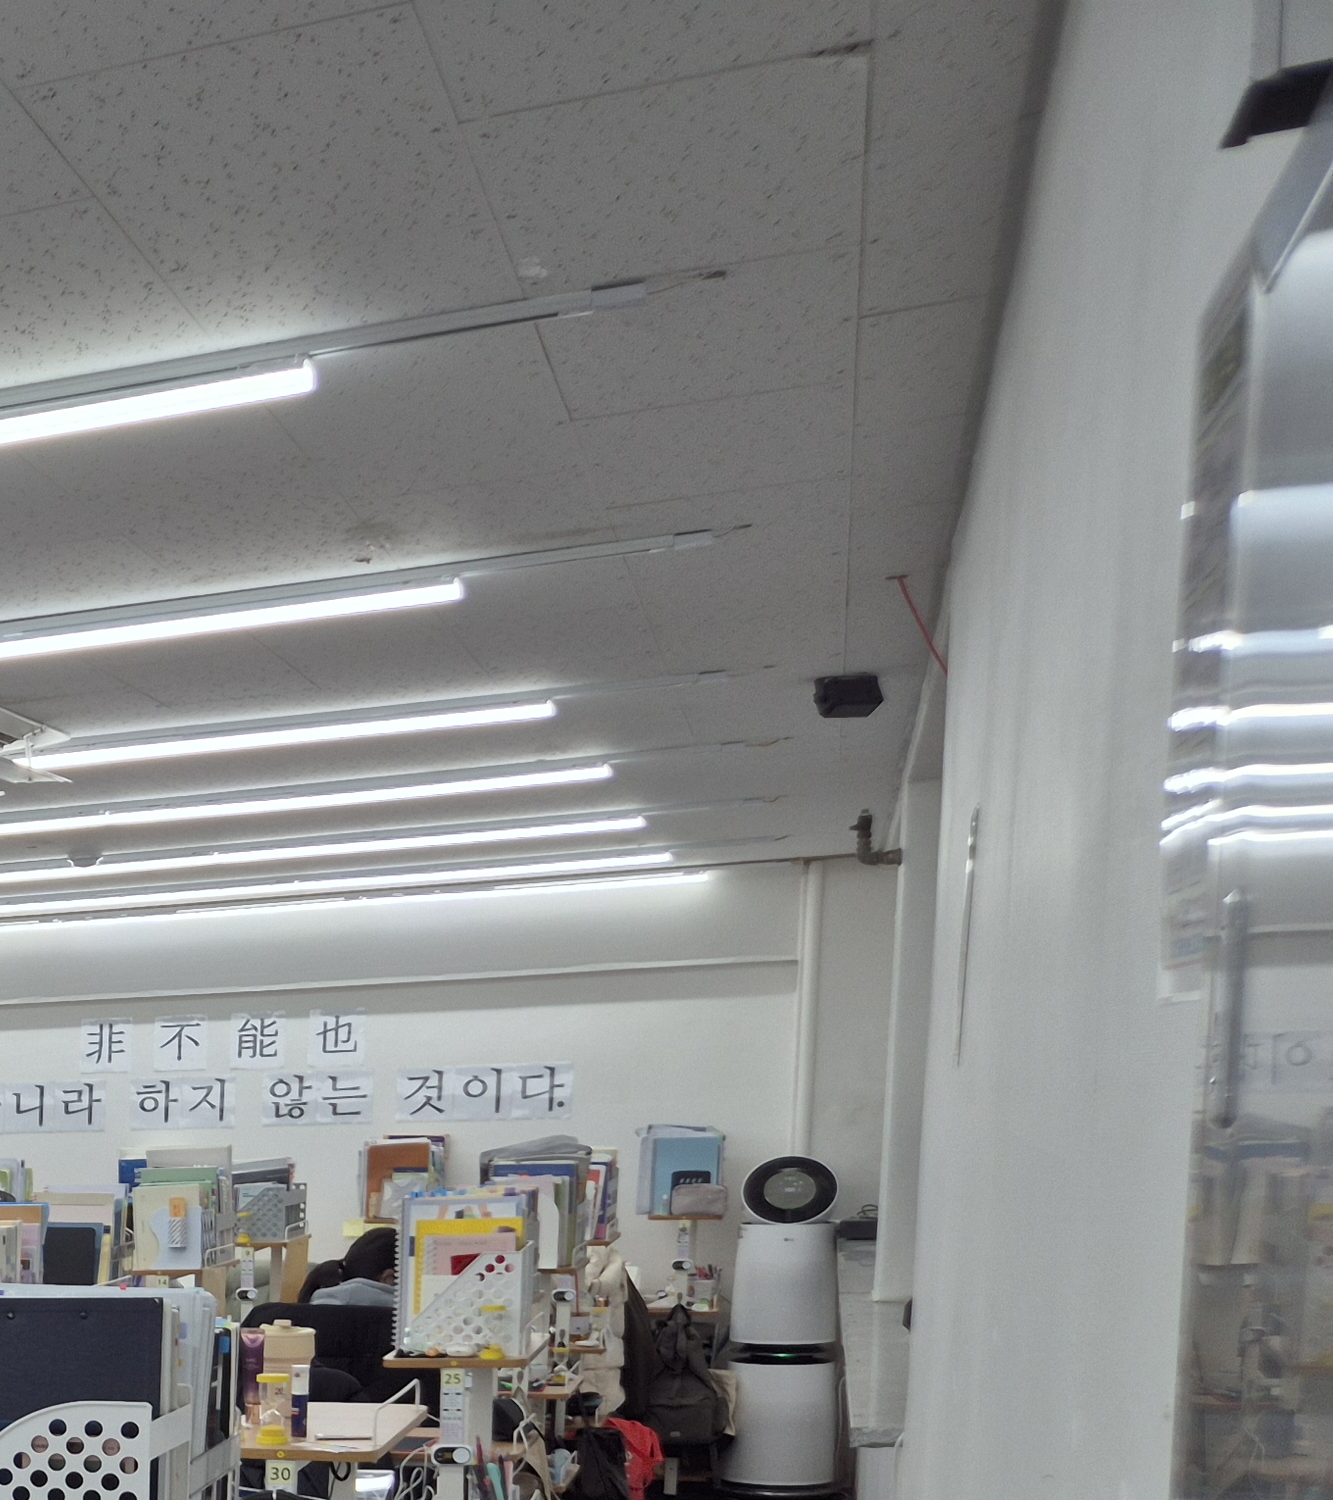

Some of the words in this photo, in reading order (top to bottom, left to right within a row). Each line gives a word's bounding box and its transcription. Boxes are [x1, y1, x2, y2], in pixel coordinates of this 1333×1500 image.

[135, 1079, 227, 1123] 하지
[269, 1074, 368, 1119] 않는
[405, 1065, 565, 1116] 것이다.
[444, 1373, 462, 1385] 25
[270, 1466, 291, 1481] 30
